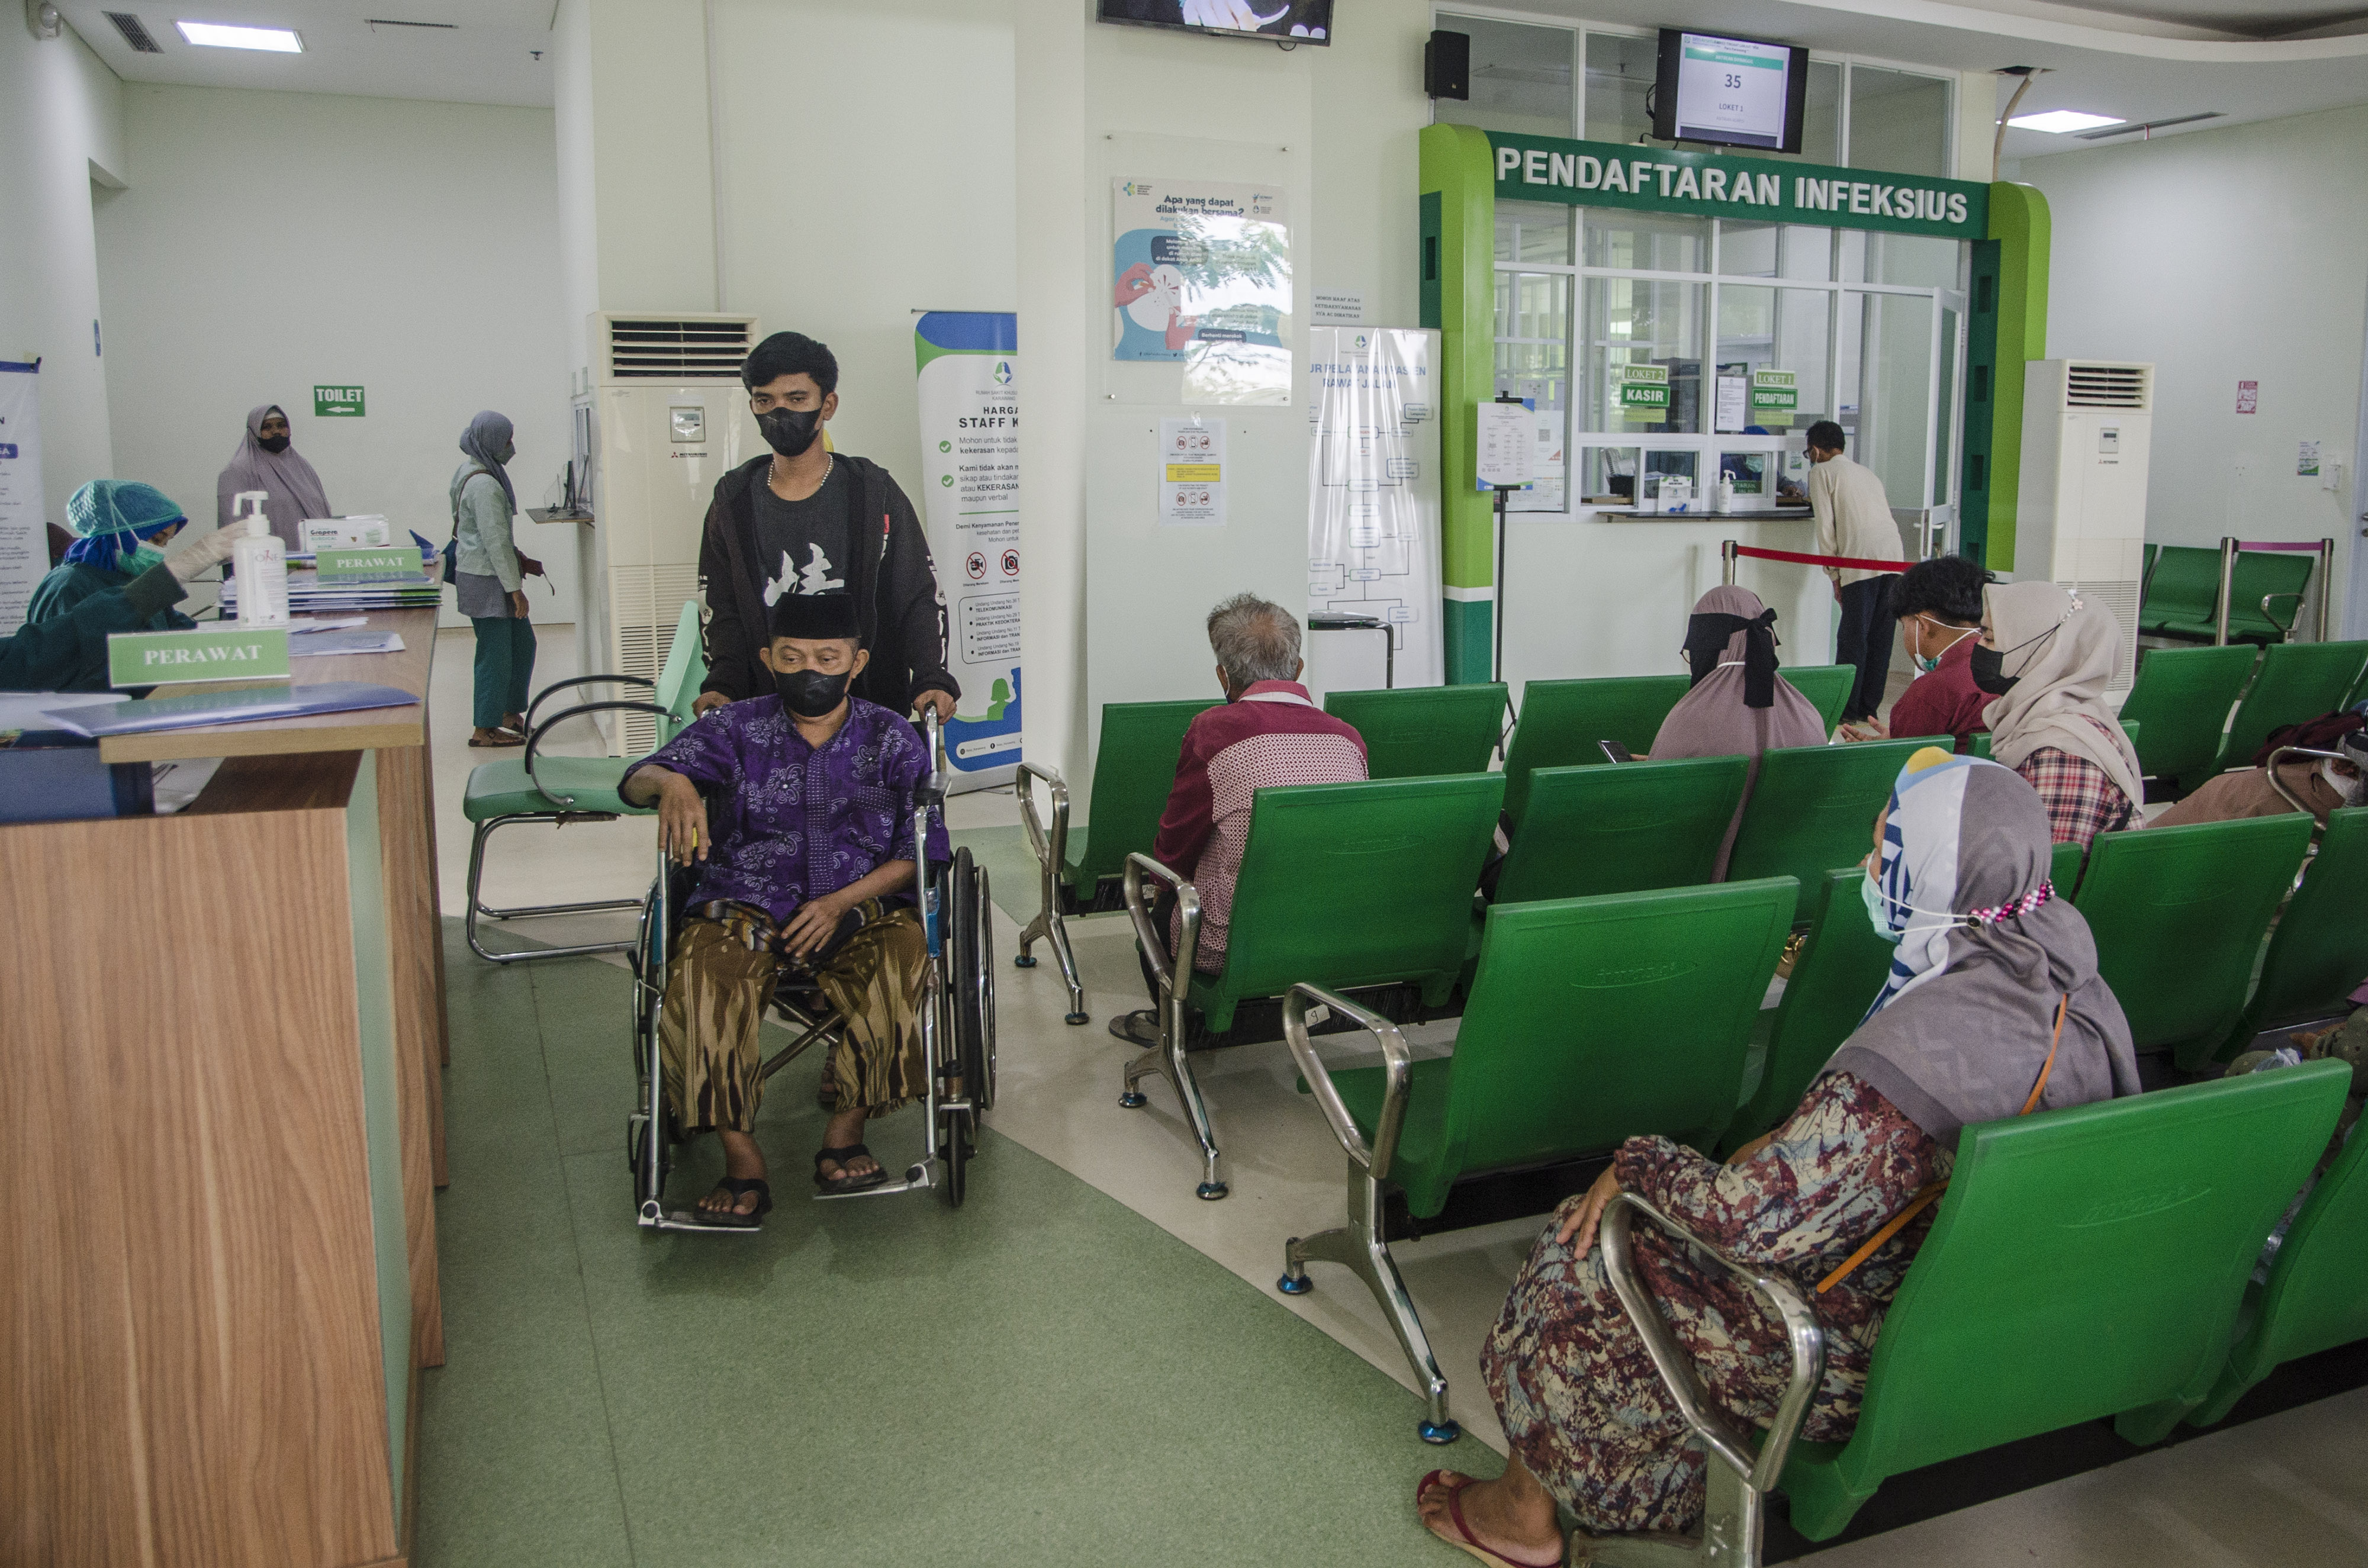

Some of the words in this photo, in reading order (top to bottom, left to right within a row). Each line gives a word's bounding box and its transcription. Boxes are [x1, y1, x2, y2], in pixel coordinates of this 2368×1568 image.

[1724, 73, 1742, 89] 35
[1495, 146, 1780, 207] PENDAFTARAN
[1794, 175, 1968, 224] INFEKSIUS
[1164, 195, 1183, 205] Apa
[1186, 198, 1205, 207] yang
[1208, 198, 1234, 208] dapat
[1201, 206, 1244, 217] bersama?
[1627, 369, 1656, 379] LOKET
[1658, 371, 1663, 379] 2
[1758, 374, 1786, 384] LOKET
[1788, 375, 1791, 384] 1
[316, 389, 363, 402] TOILET
[1627, 389, 1664, 402] KASIR
[1755, 393, 1794, 404] PENDAFTARAN
[959, 418, 1005, 428] STAFF
[336, 557, 404, 568] PERAWAT
[144, 645, 262, 665] PERAWAT
